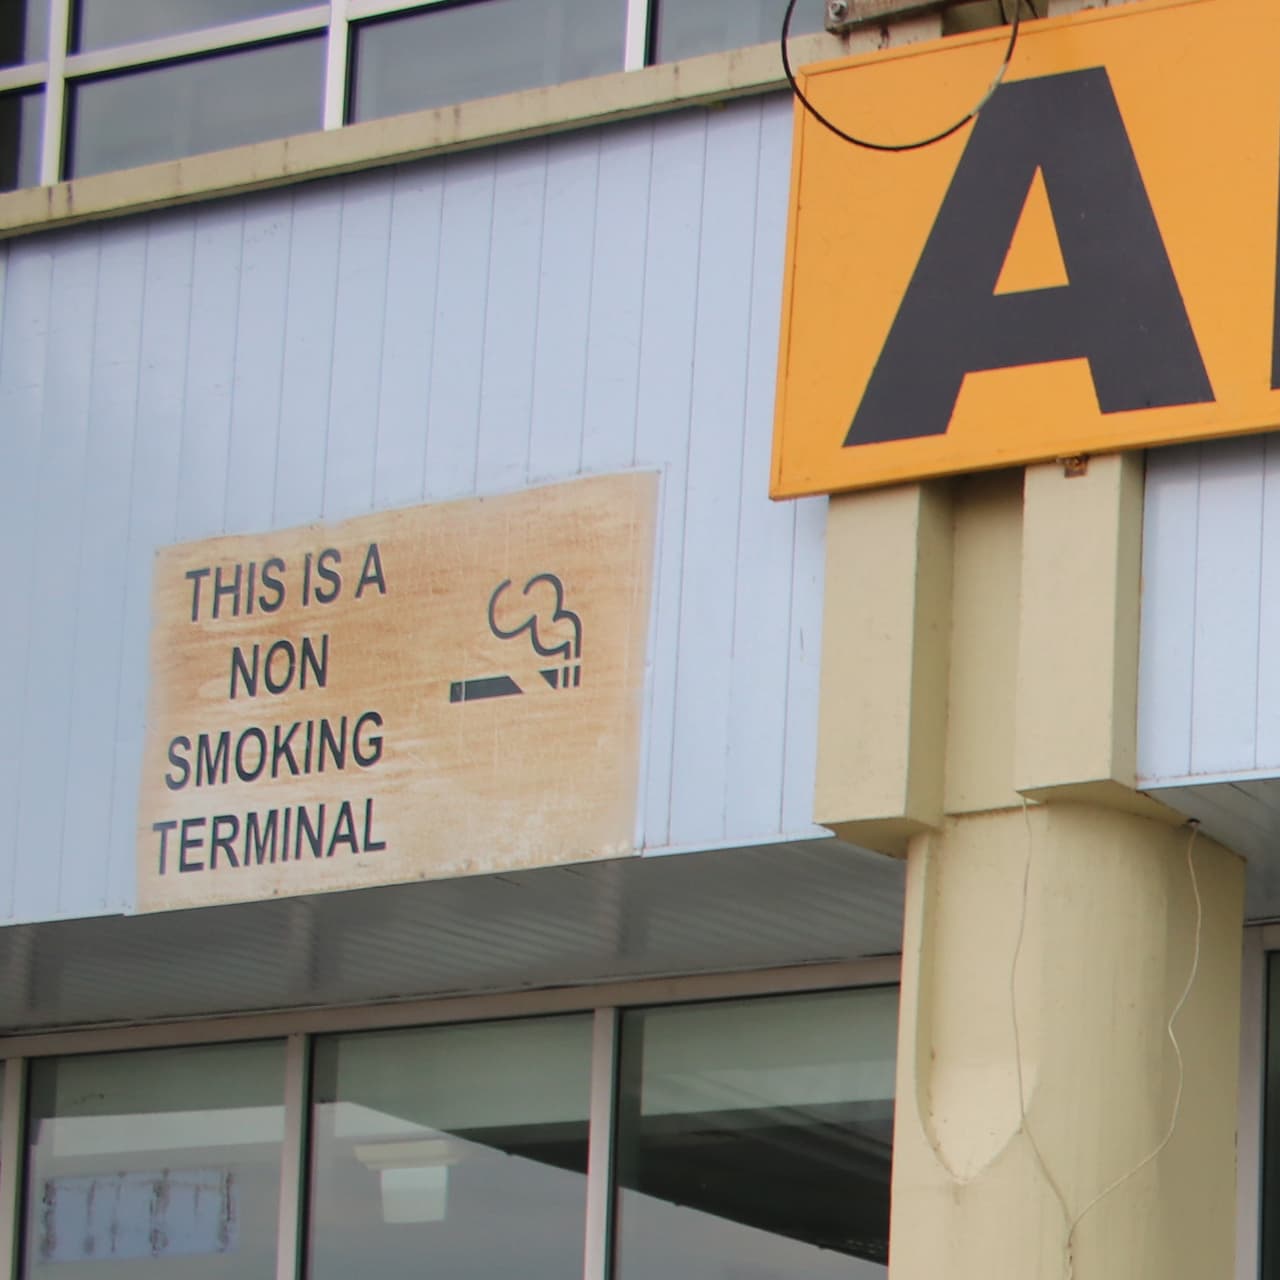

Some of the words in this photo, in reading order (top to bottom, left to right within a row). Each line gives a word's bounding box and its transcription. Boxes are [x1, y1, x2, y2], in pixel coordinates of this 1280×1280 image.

[185, 557, 287, 623] THIS
[303, 547, 343, 607] IS
[355, 543, 387, 599] A
[230, 633, 330, 700] NON
[165, 711, 385, 792] SMOKING
[152, 798, 387, 876] TERMINAL
